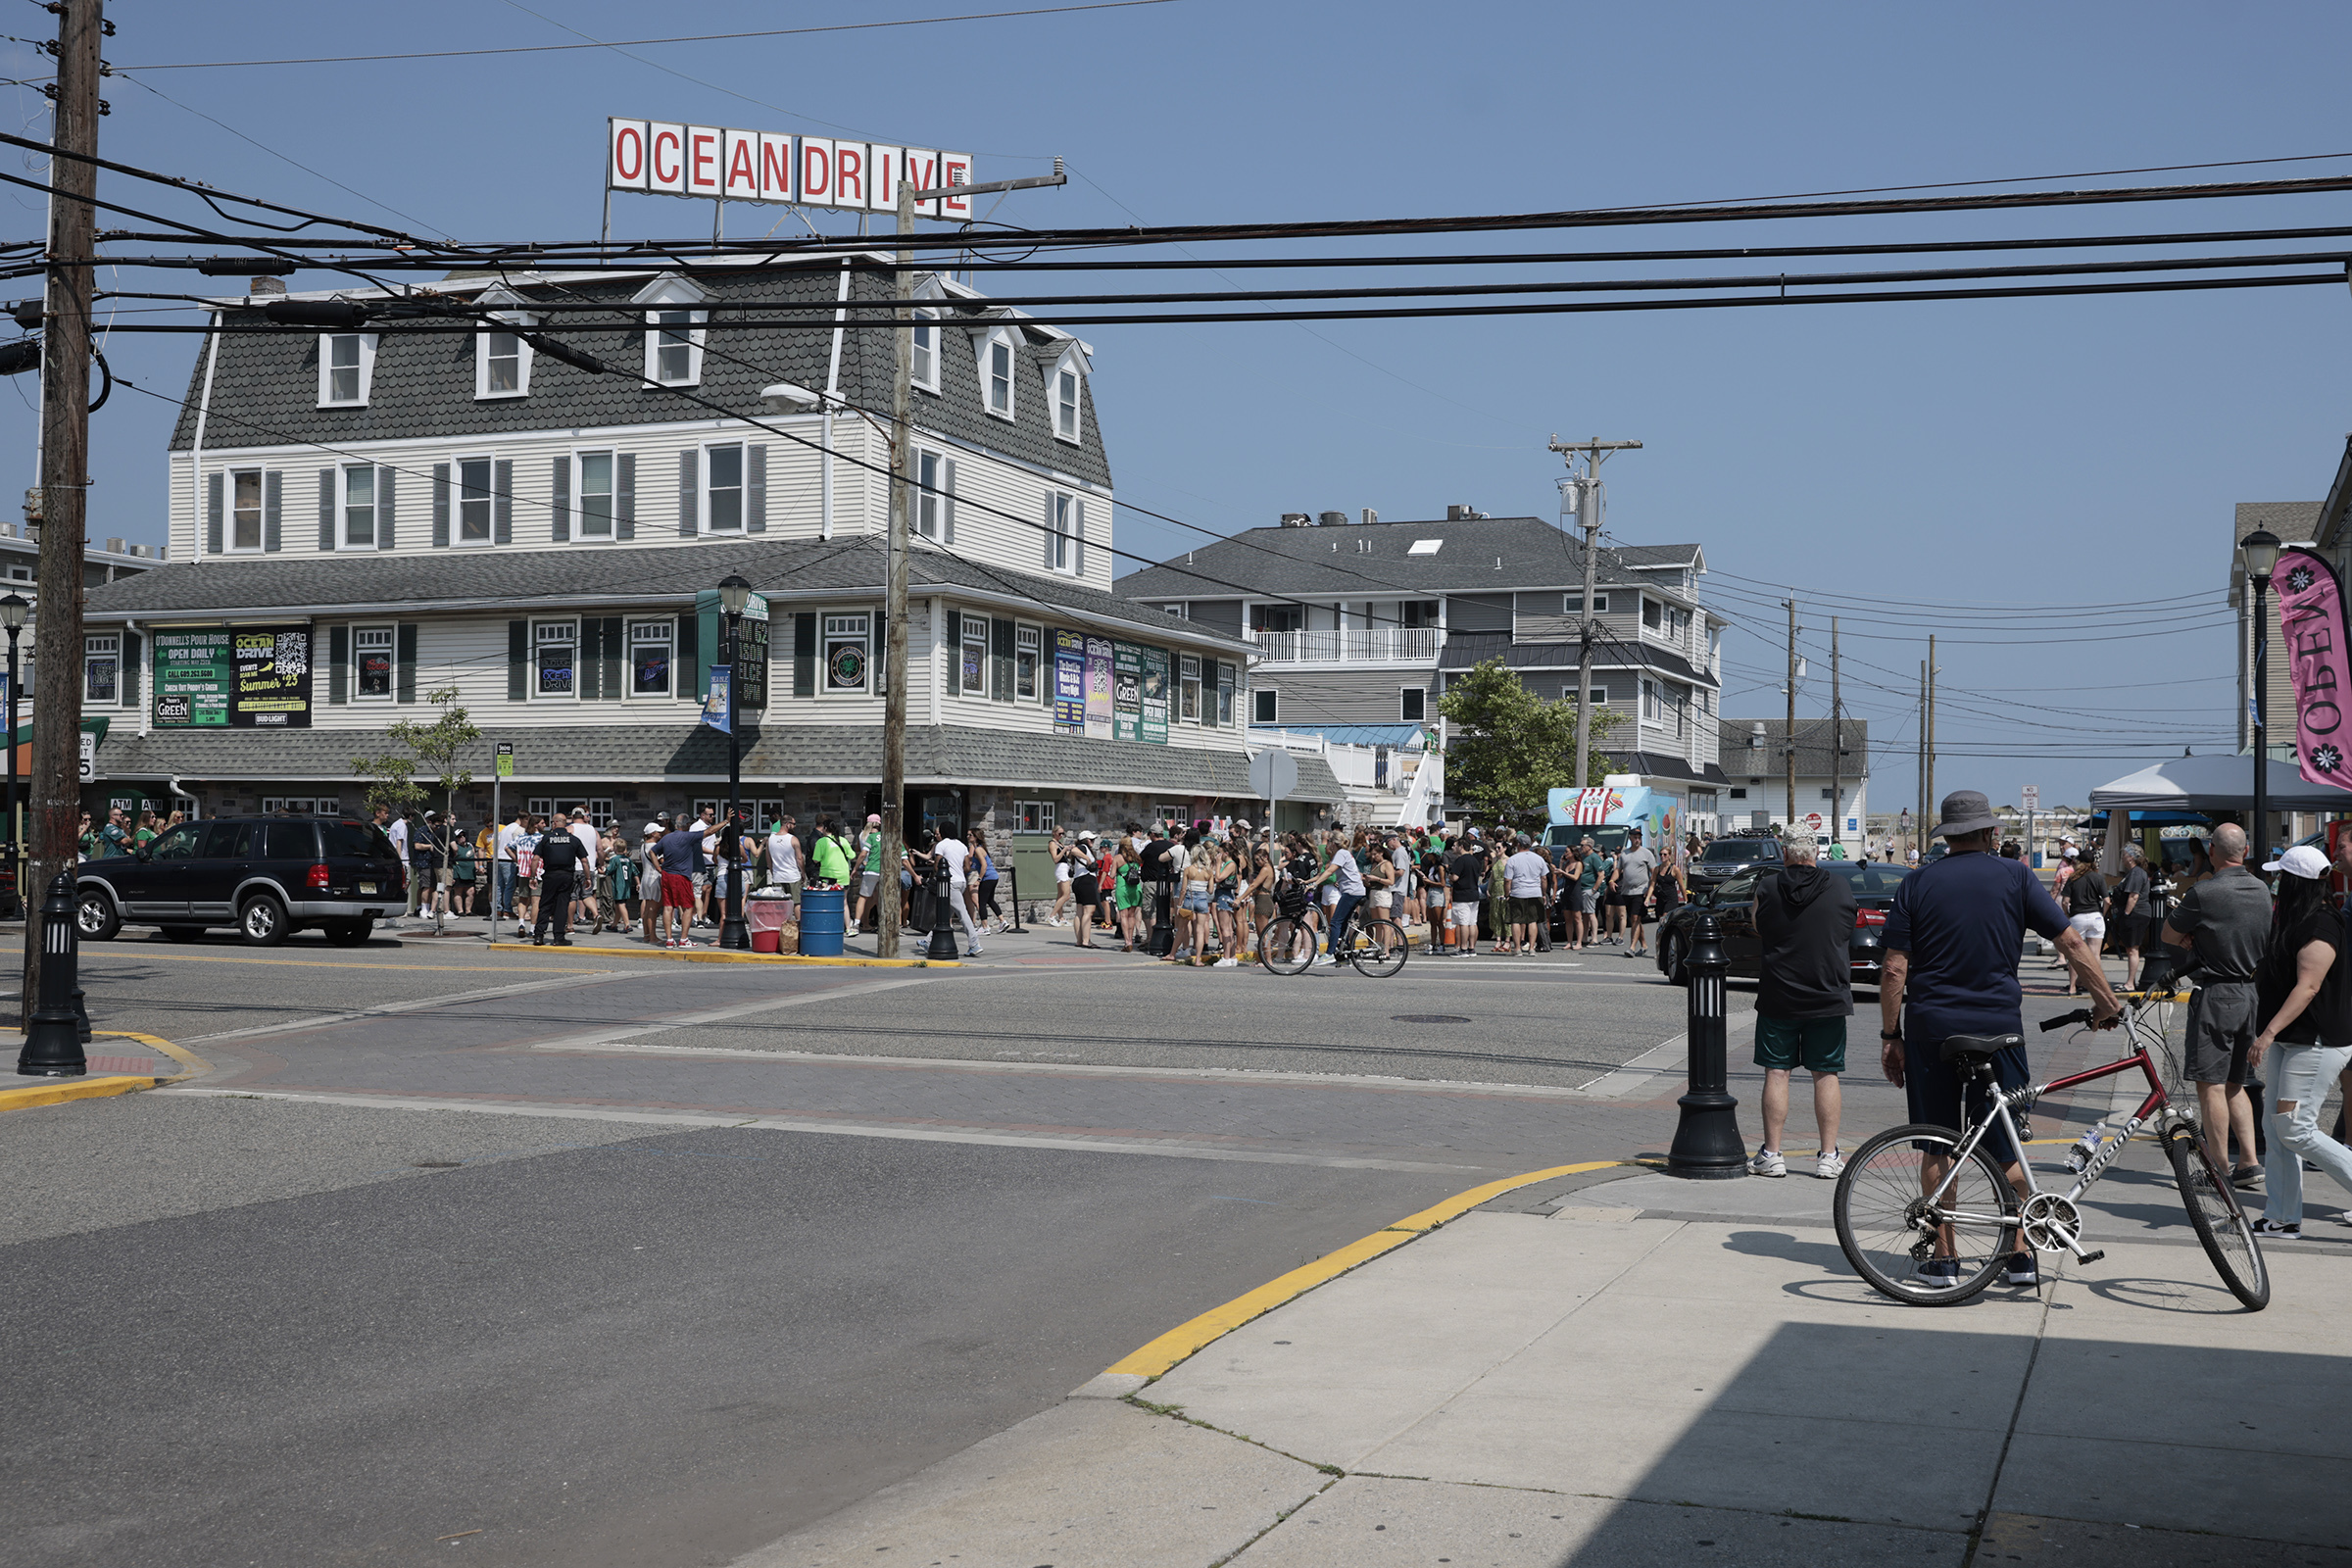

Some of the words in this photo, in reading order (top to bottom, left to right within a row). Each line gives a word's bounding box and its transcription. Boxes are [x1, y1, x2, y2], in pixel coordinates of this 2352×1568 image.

[615, 127, 789, 194] OCEAN
[805, 145, 967, 212] DRIVE
[155, 635, 190, 646] O'DONNELL'S
[190, 635, 208, 646] POUR
[209, 634, 229, 645] HOUSE
[235, 637, 274, 649] OCEAN
[168, 649, 189, 660] OPEN
[191, 648, 215, 659] DAILY
[235, 648, 274, 659] DRIVE
[2291, 587, 2341, 735] OPEN
[93, 675, 115, 684] LIGH
[239, 677, 281, 692] Summer
[1117, 683, 1139, 703] GREEN
[158, 703, 187, 715] GREEN
[79, 759, 91, 776] 5
[112, 799, 132, 809] ATM
[143, 800, 163, 810] ATM
[622, 865, 628, 880] 6
[2079, 1122, 2135, 1190] Raleigh
